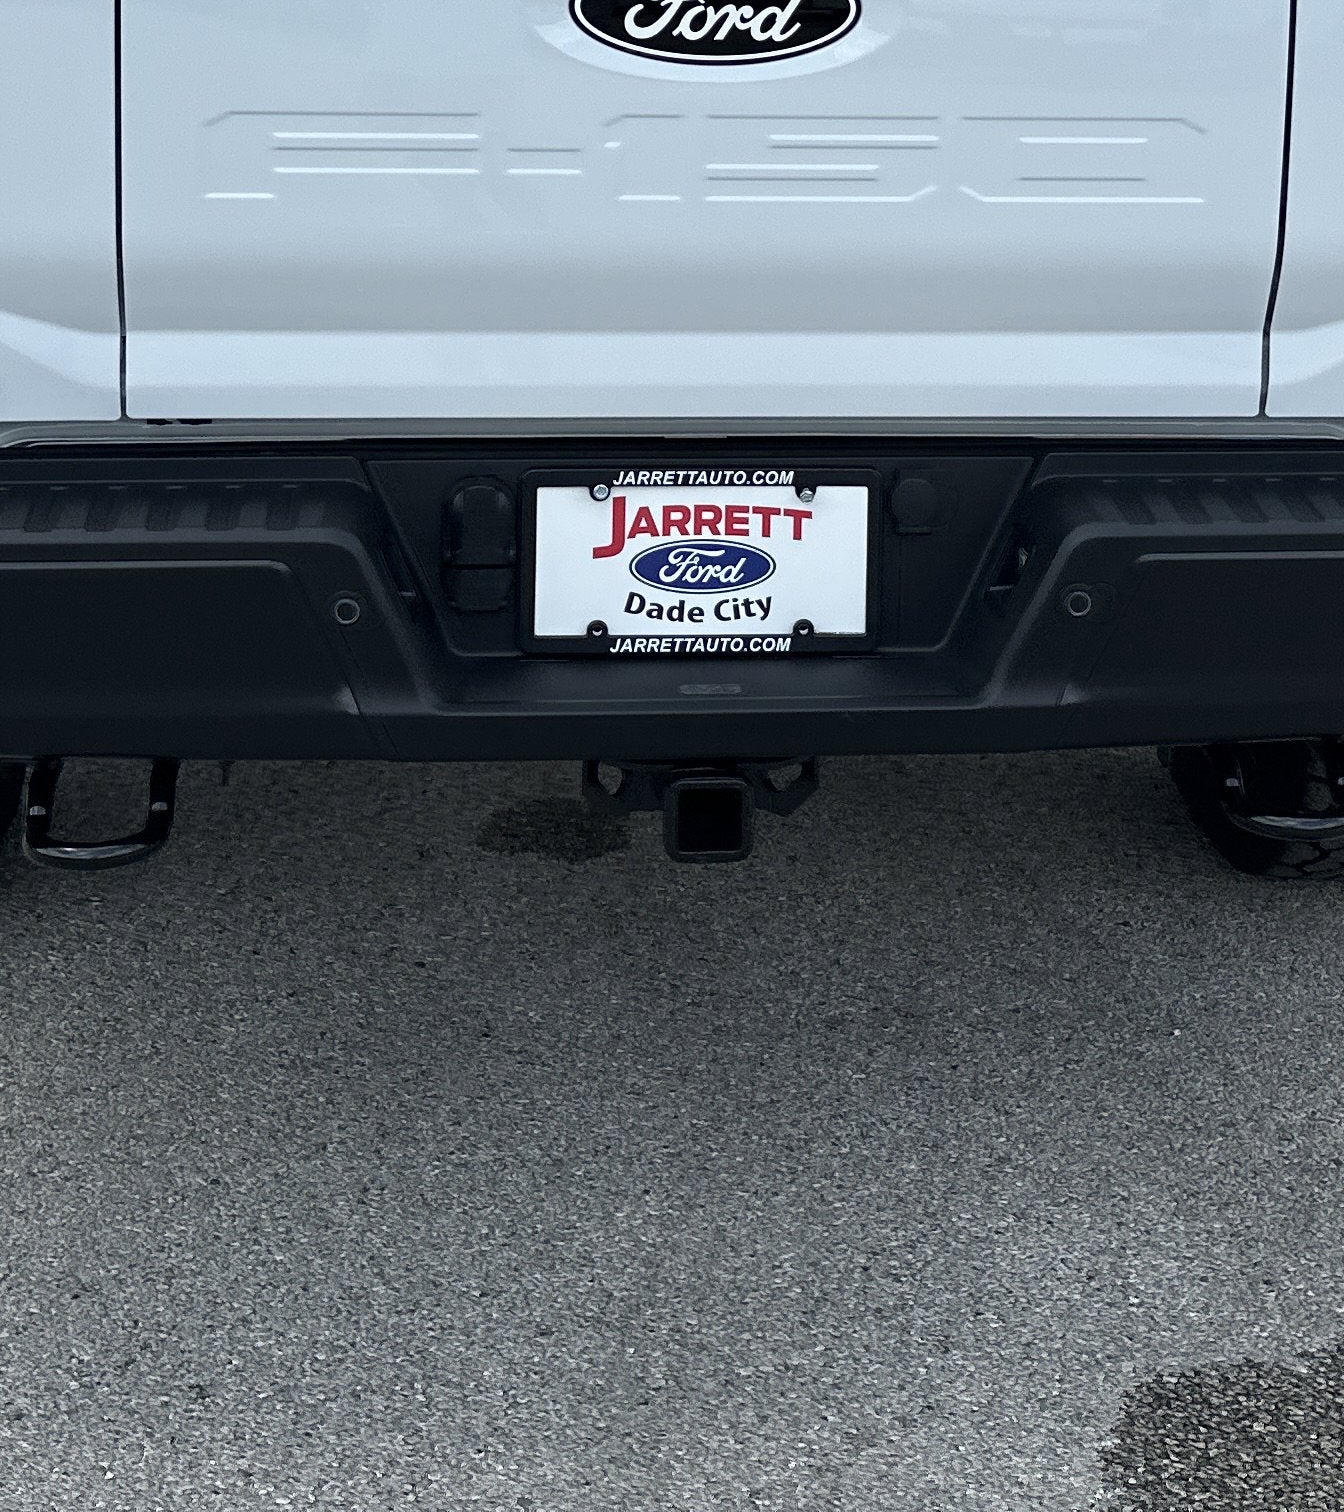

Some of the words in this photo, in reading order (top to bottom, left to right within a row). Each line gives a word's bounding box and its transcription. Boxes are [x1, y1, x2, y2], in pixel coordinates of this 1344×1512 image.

[203, 110, 1206, 205] F-150
[612, 470, 795, 486] JARRETTAUTO.COM
[592, 495, 813, 560] JARRETT
[658, 546, 748, 585] Ford
[623, 591, 705, 623] Dade
[713, 595, 773, 623] City
[609, 636, 792, 654] JARRETTAUTO.COM
